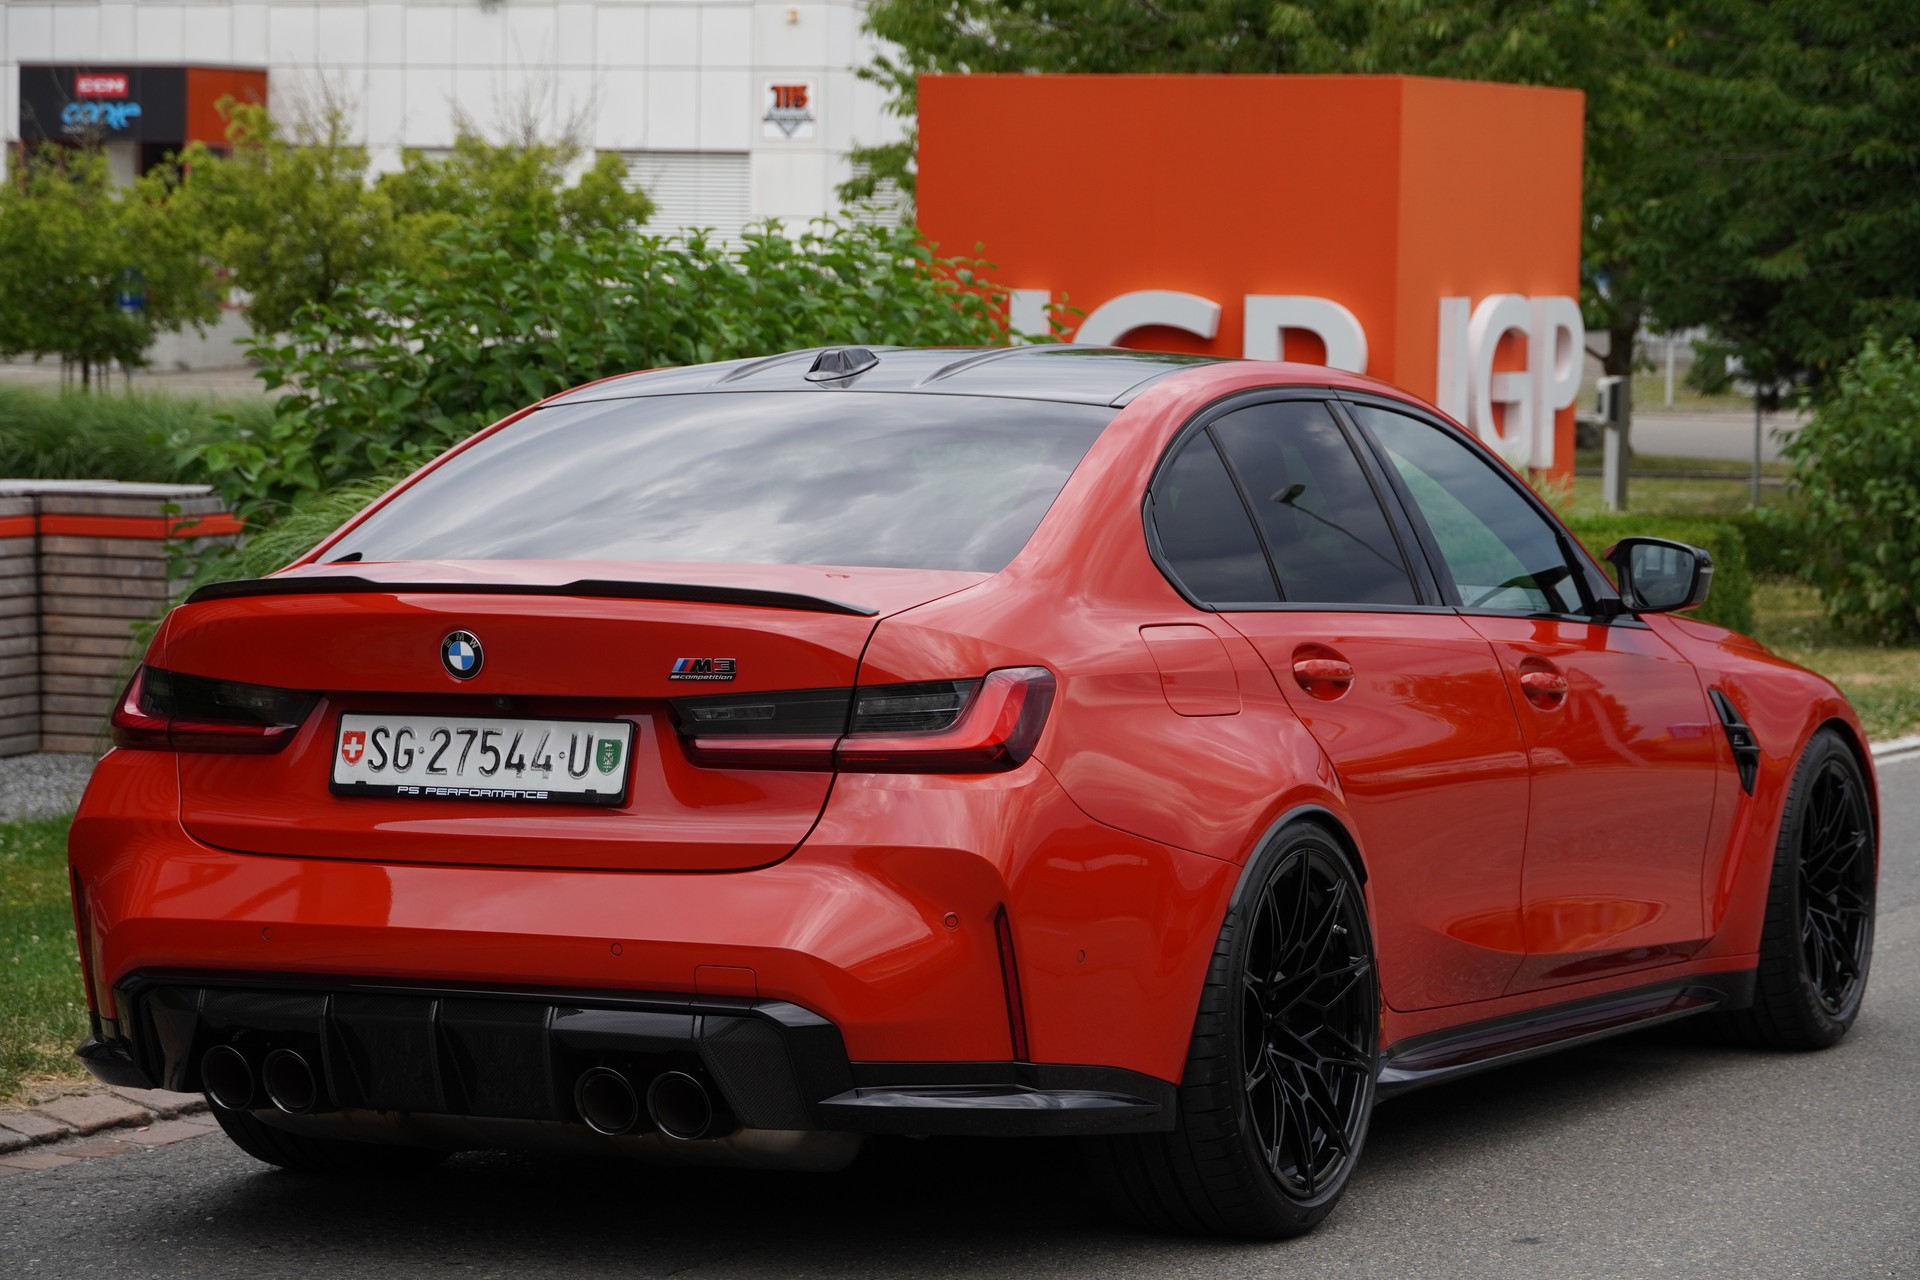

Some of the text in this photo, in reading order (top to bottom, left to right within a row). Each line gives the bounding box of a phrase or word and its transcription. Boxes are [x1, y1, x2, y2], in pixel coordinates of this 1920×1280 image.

[1438, 294, 1584, 468] IGP
[444, 633, 479, 649] BMW
[686, 658, 736, 673] M3
[397, 786, 549, 799] PS PERFORMANCE
